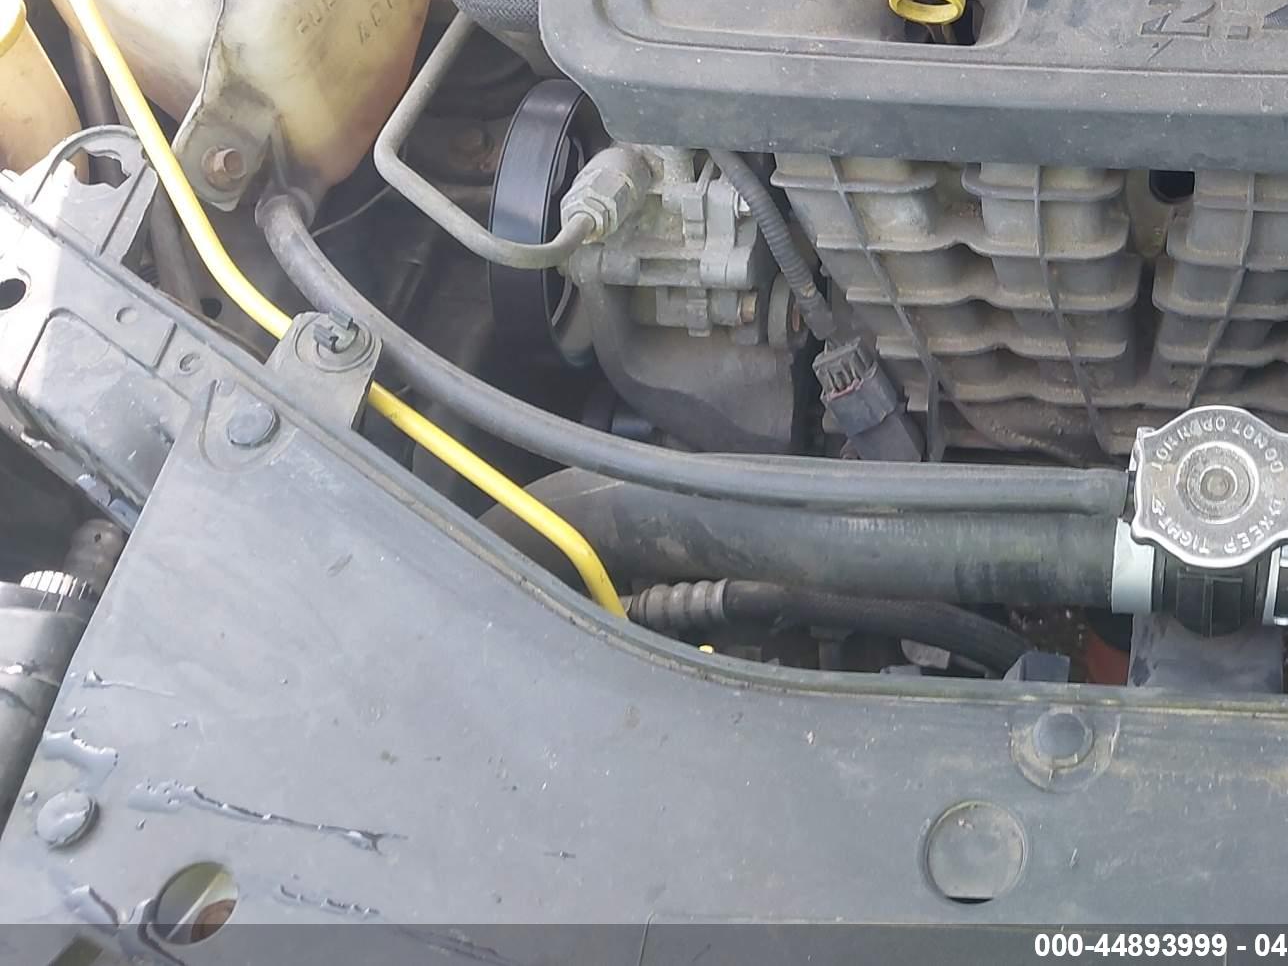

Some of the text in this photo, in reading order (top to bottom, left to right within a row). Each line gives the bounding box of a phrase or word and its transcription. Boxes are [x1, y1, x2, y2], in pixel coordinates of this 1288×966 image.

[1232, 420, 1268, 449] NOT
[1151, 437, 1178, 472] HOT
[1265, 448, 1284, 473] DO
[1158, 516, 1275, 554] KEEP TIGHT
